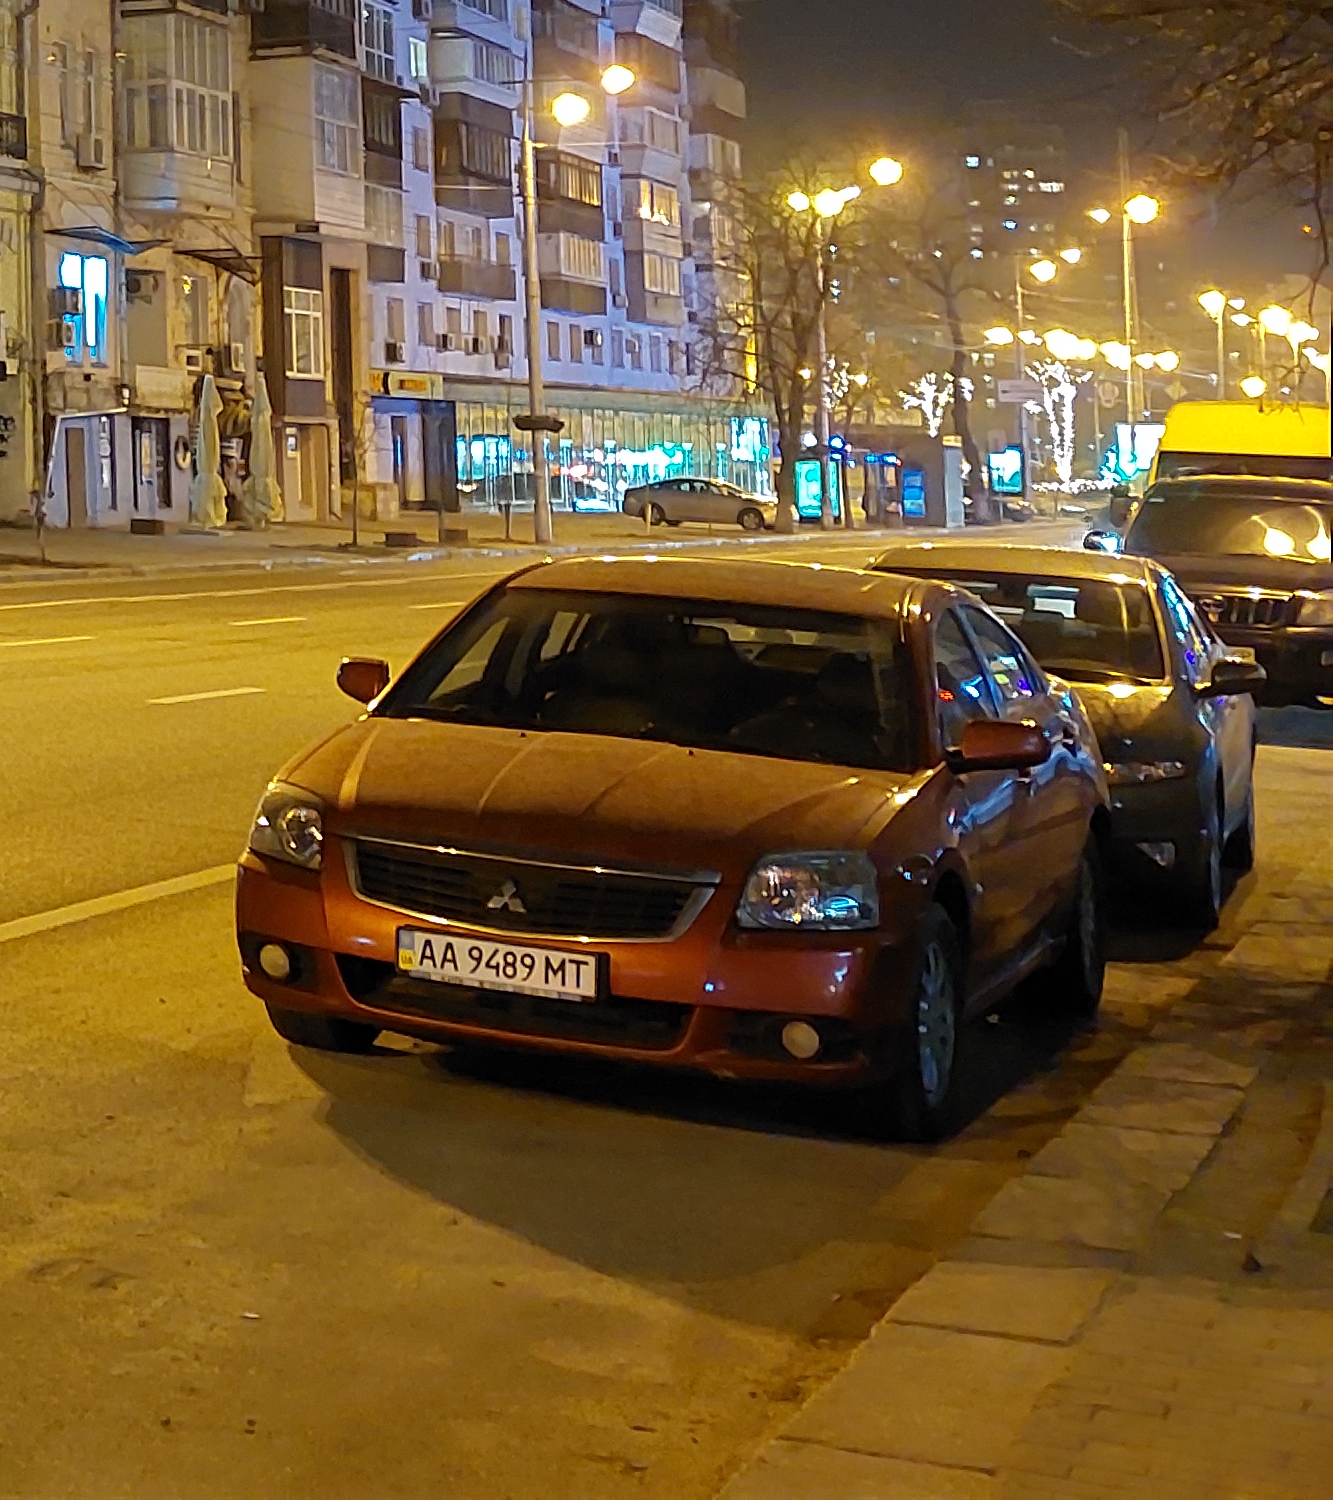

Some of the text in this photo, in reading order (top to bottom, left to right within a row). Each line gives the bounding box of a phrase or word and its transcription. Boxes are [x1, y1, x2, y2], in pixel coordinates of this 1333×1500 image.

[419, 938, 590, 989] AA 9489 MT
